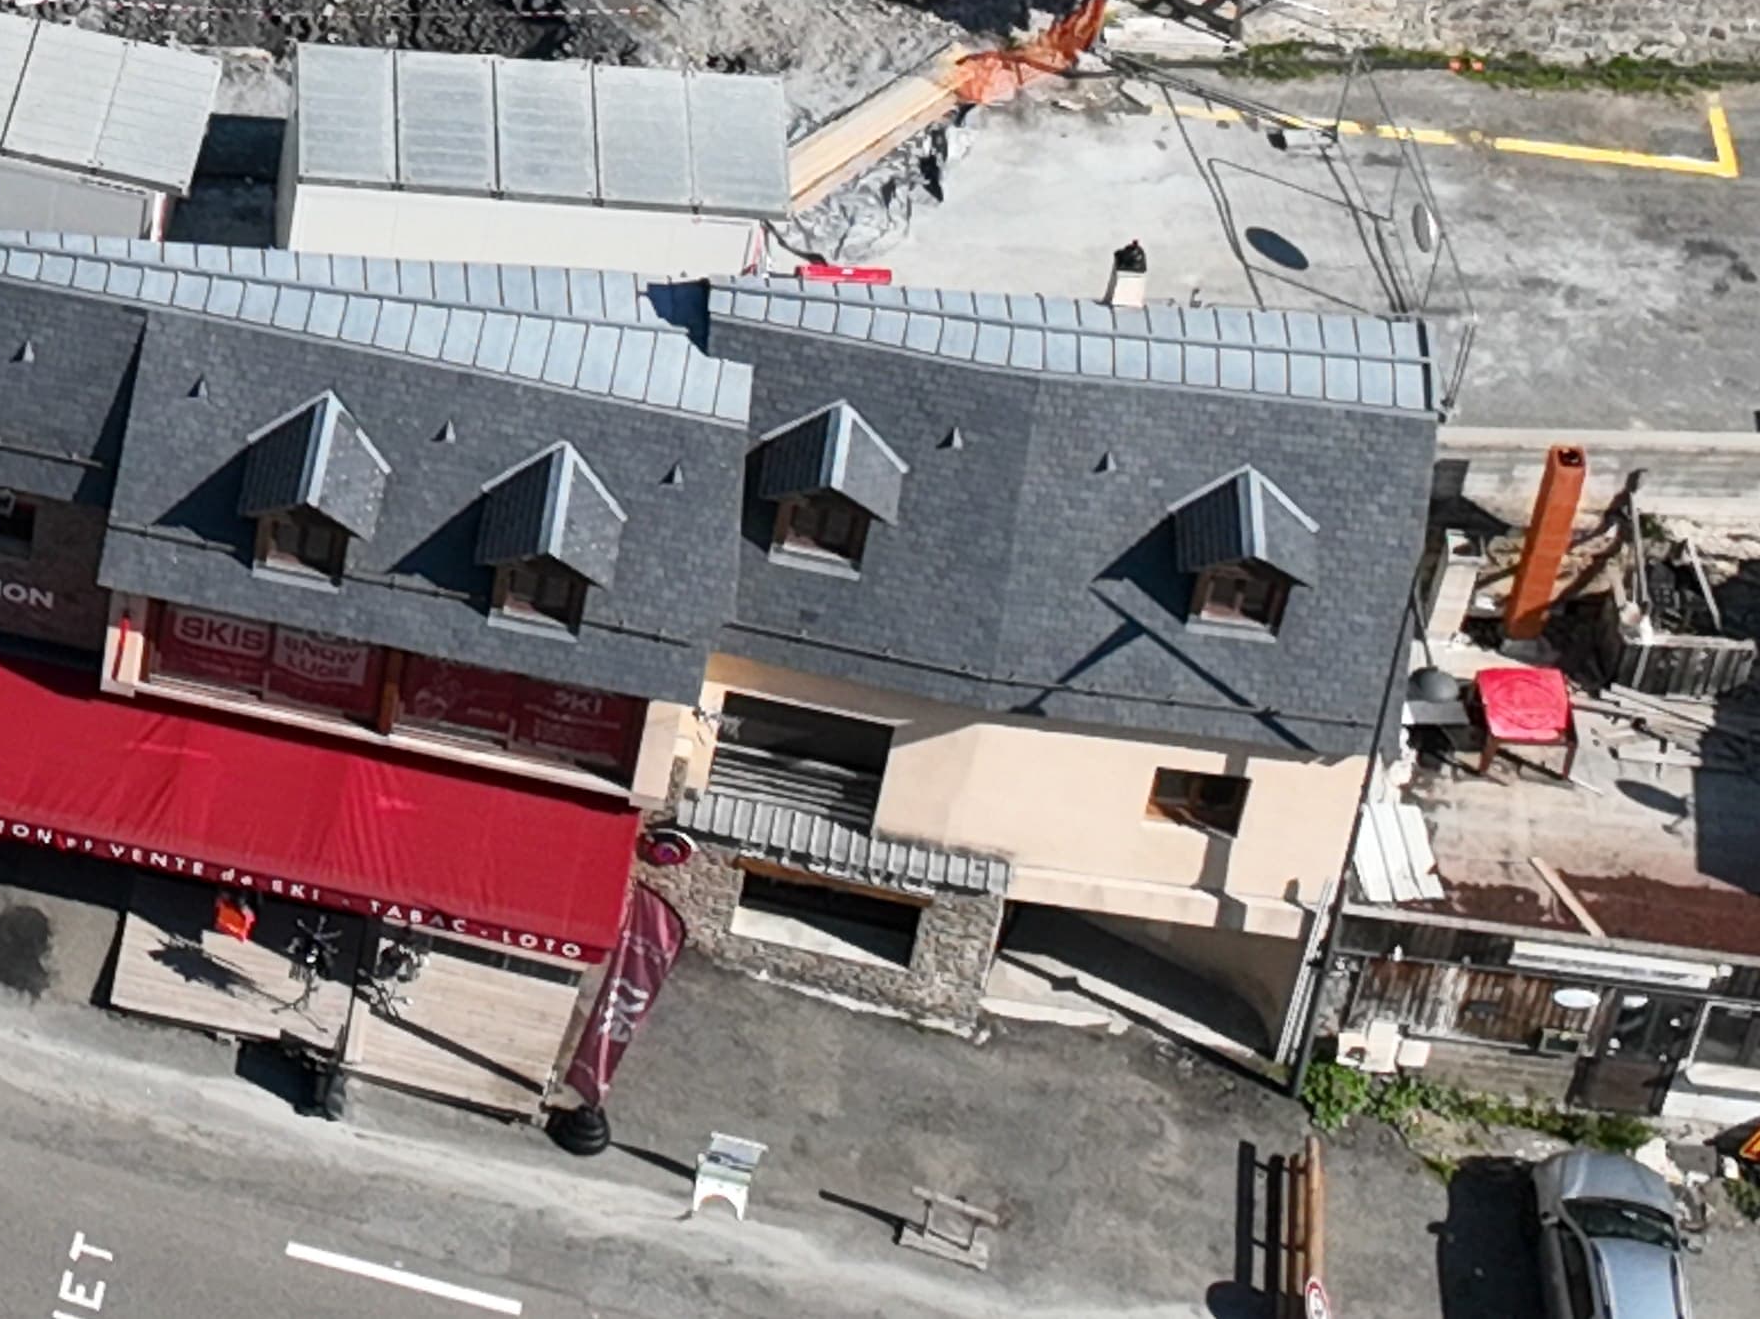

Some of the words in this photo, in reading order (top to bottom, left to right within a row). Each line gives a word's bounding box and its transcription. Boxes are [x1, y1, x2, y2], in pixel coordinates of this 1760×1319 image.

[179, 615, 267, 652] SKIS
[110, 844, 205, 876] VENTE
[220, 867, 254, 887] de
[271, 879, 320, 902] SKI
[370, 899, 467, 933] TABAC
[503, 930, 582, 959] LOTO
